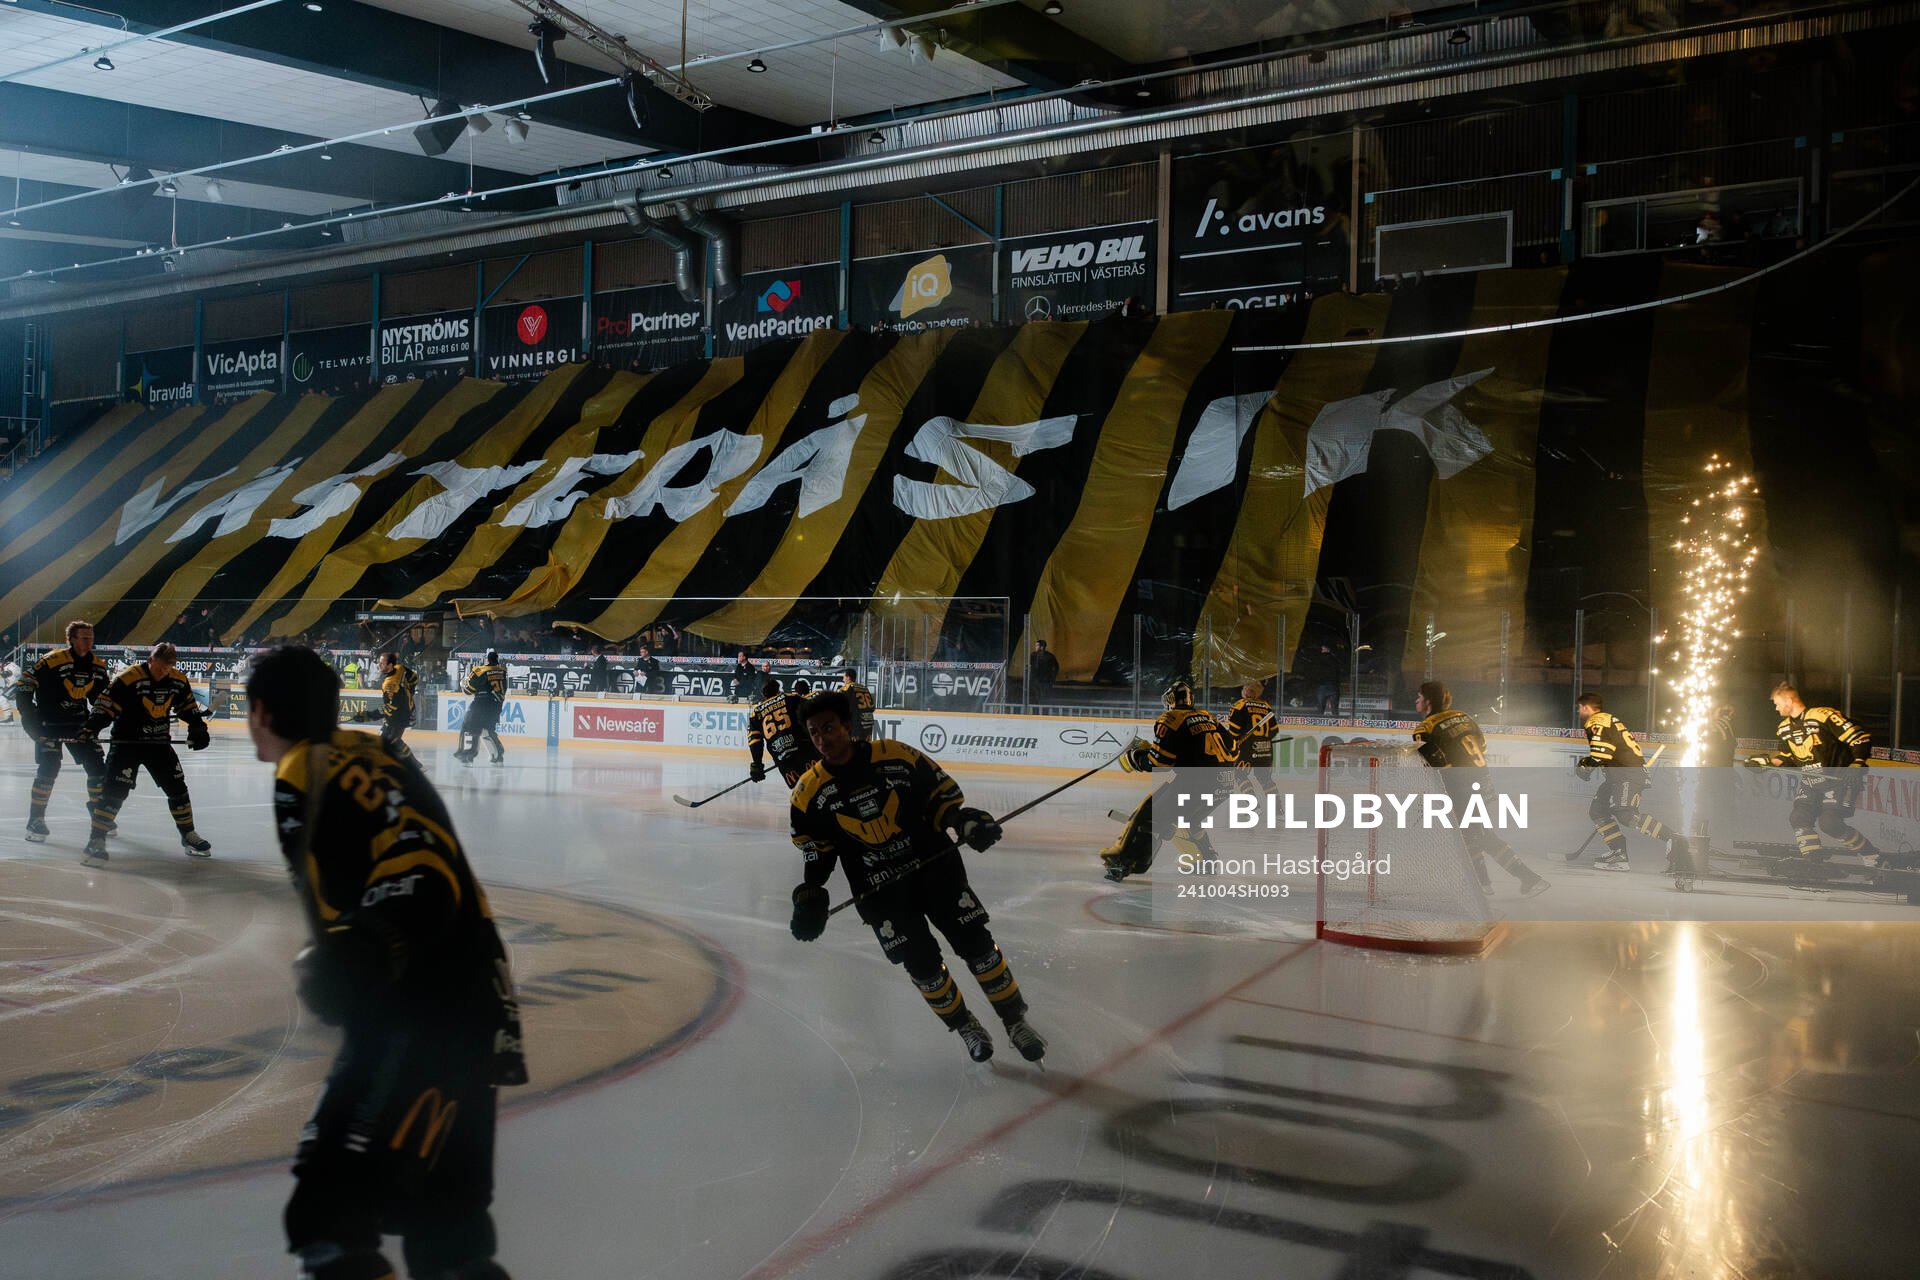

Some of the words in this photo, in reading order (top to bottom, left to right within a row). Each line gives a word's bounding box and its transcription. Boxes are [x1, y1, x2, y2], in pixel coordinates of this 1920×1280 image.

[1238, 205, 1326, 233] avans
[1011, 241, 1097, 274] VEHO
[1096, 235, 1146, 265] BIL
[1011, 270, 1081, 288] FINNSLÄTTEN
[1090, 262, 1146, 280] VÄSTERÅS
[911, 272, 939, 298] iQ
[1056, 299, 1126, 315] Mercedes-Ben
[382, 317, 470, 347] NYSTRÖMS
[725, 313, 833, 341] VentPartner
[206, 348, 278, 377] VicApta
[319, 356, 372, 370] TELWAYS
[381, 342, 425, 366] BILAR
[489, 348, 576, 370] VINNERGI
[149, 380, 194, 403] bravida
[176, 660, 208, 673] BOHEDS
[529, 673, 558, 691] FVB
[690, 677, 724, 696] FVB
[894, 675, 917, 694] VB
[953, 676, 992, 697] FVB
[496, 722, 526, 734] EKNIK
[596, 715, 657, 734] Newsafe
[706, 711, 750, 731] STEN
[762, 707, 792, 740] 65
[873, 719, 902, 740] NT
[1280, 715, 1330, 726] INTERSPORT
[1338, 718, 1390, 729] INTERSPORT
[1396, 720, 1421, 729] INTER
[951, 733, 1039, 749] WARRIOR
[1059, 728, 1123, 747] GA
[956, 748, 1029, 758] BREAKTHROUGH
[1078, 751, 1100, 760] GANT
[1102, 752, 1113, 760] ST
